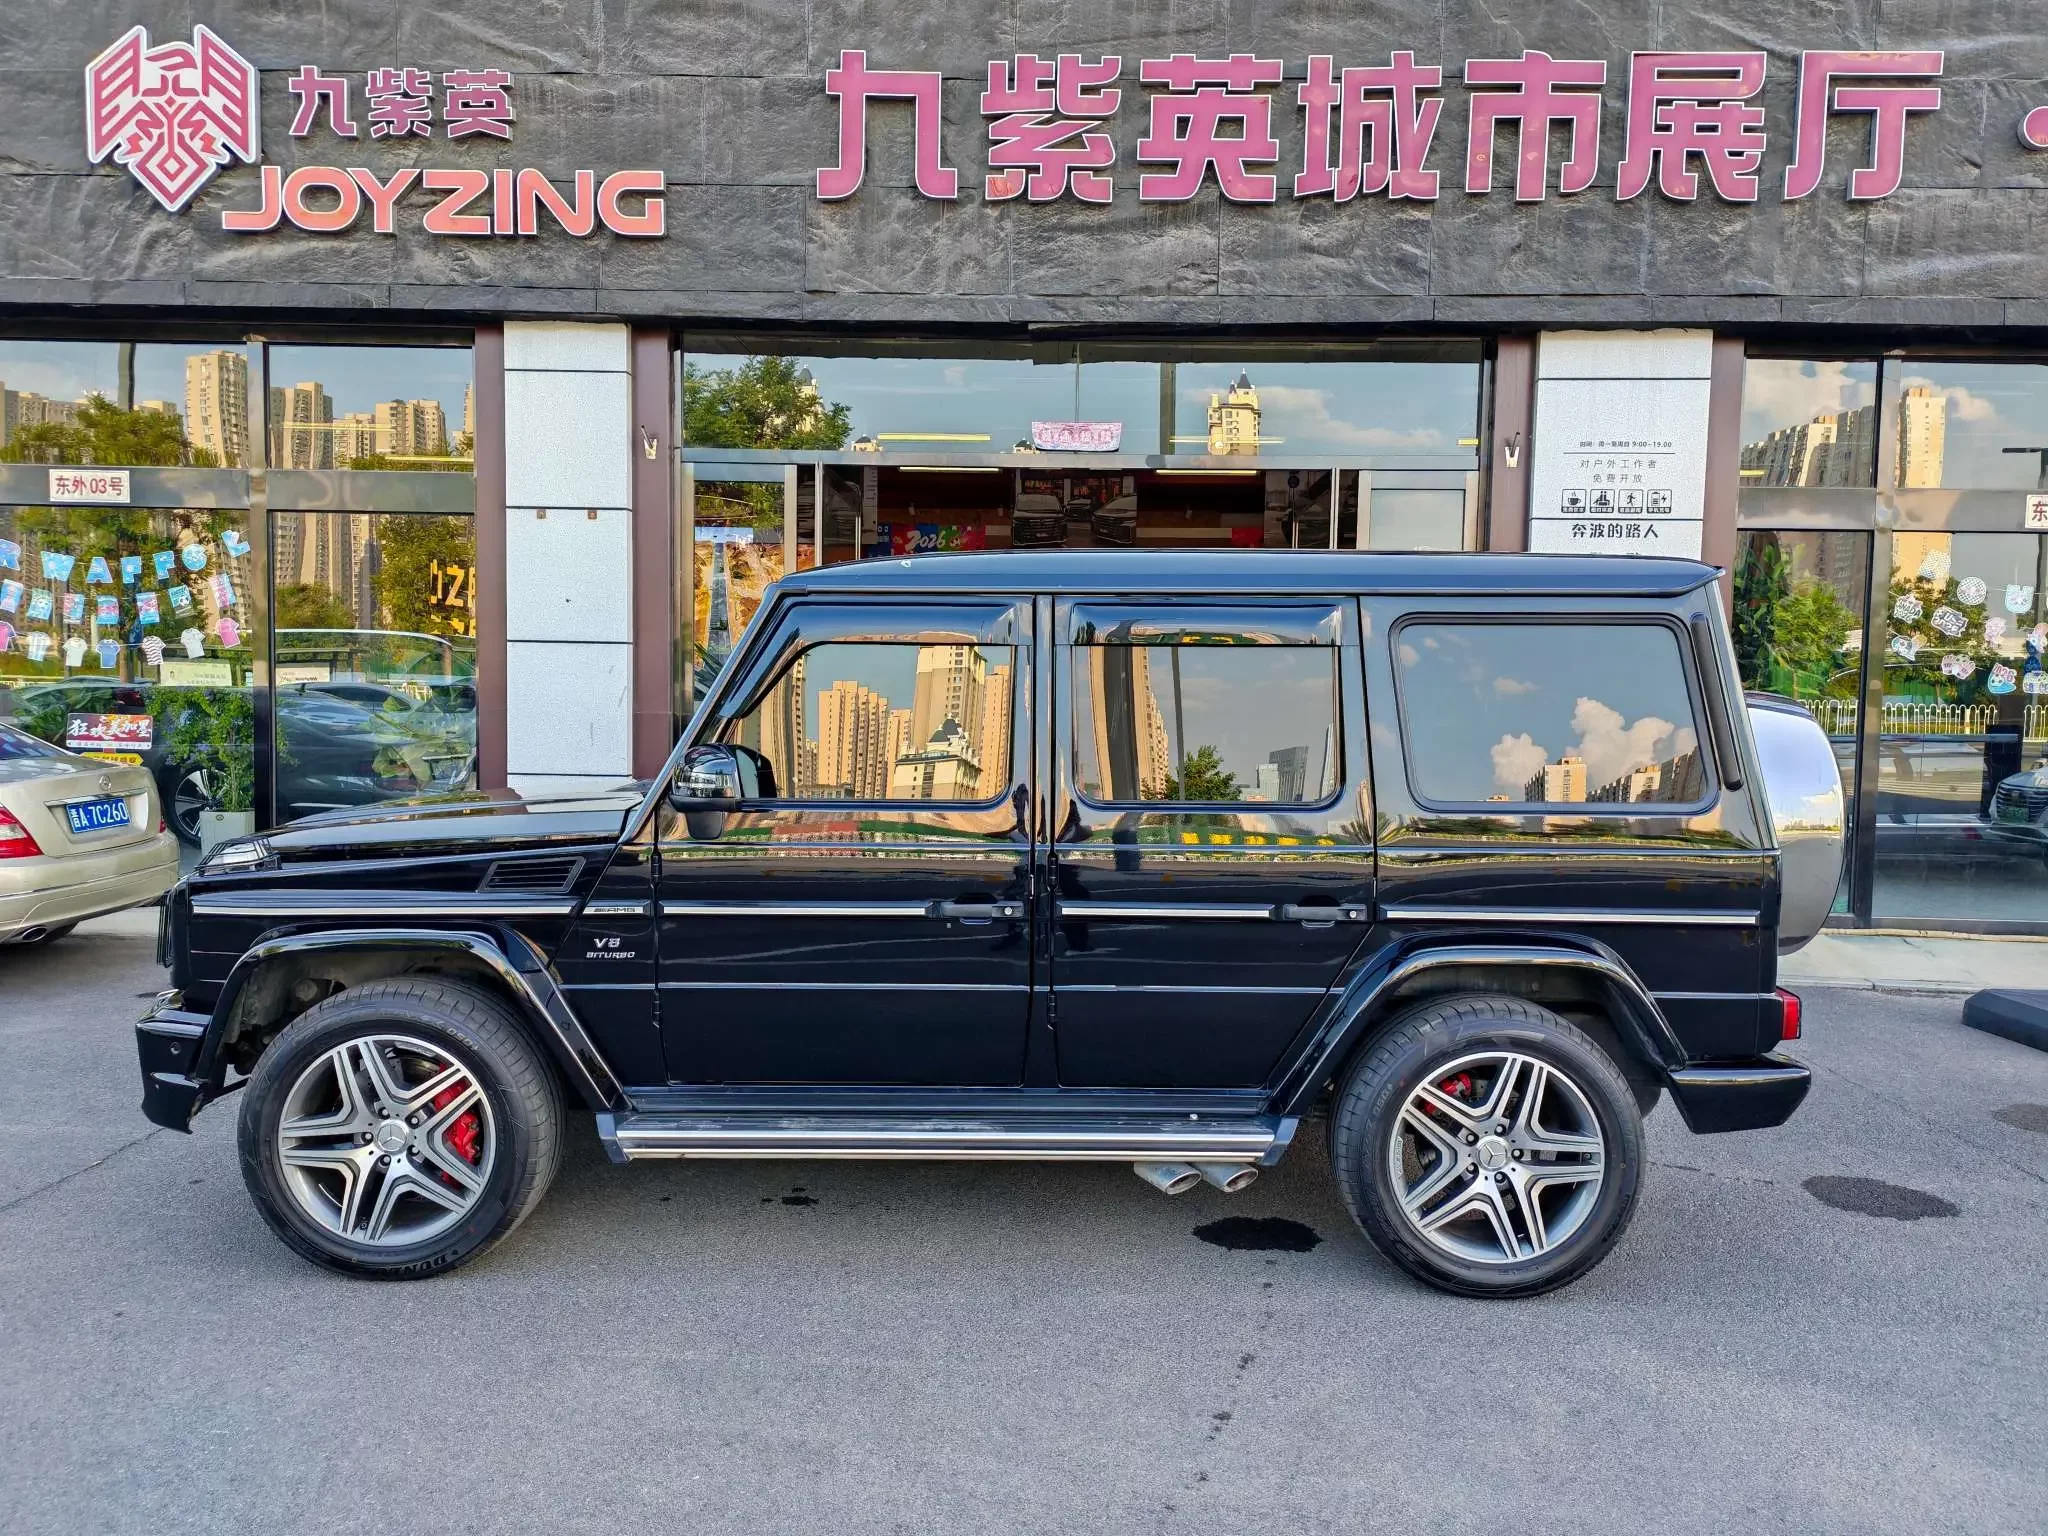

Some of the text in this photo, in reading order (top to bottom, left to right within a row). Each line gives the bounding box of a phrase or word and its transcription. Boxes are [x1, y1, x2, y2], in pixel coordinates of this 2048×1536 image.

[287, 65, 516, 140] 九紫英
[815, 48, 1946, 204] 九紫英城市展厅
[221, 165, 667, 238] JOYZING
[1579, 458, 1658, 469] 对户外工作者
[54, 475, 125, 497] 东外03号
[1592, 473, 1643, 483] 免费开放
[2031, 500, 2048, 522] 东
[1571, 522, 1660, 539] 奔波的路人
[594, 937, 621, 949] V8
[585, 951, 636, 959] BITURBO
